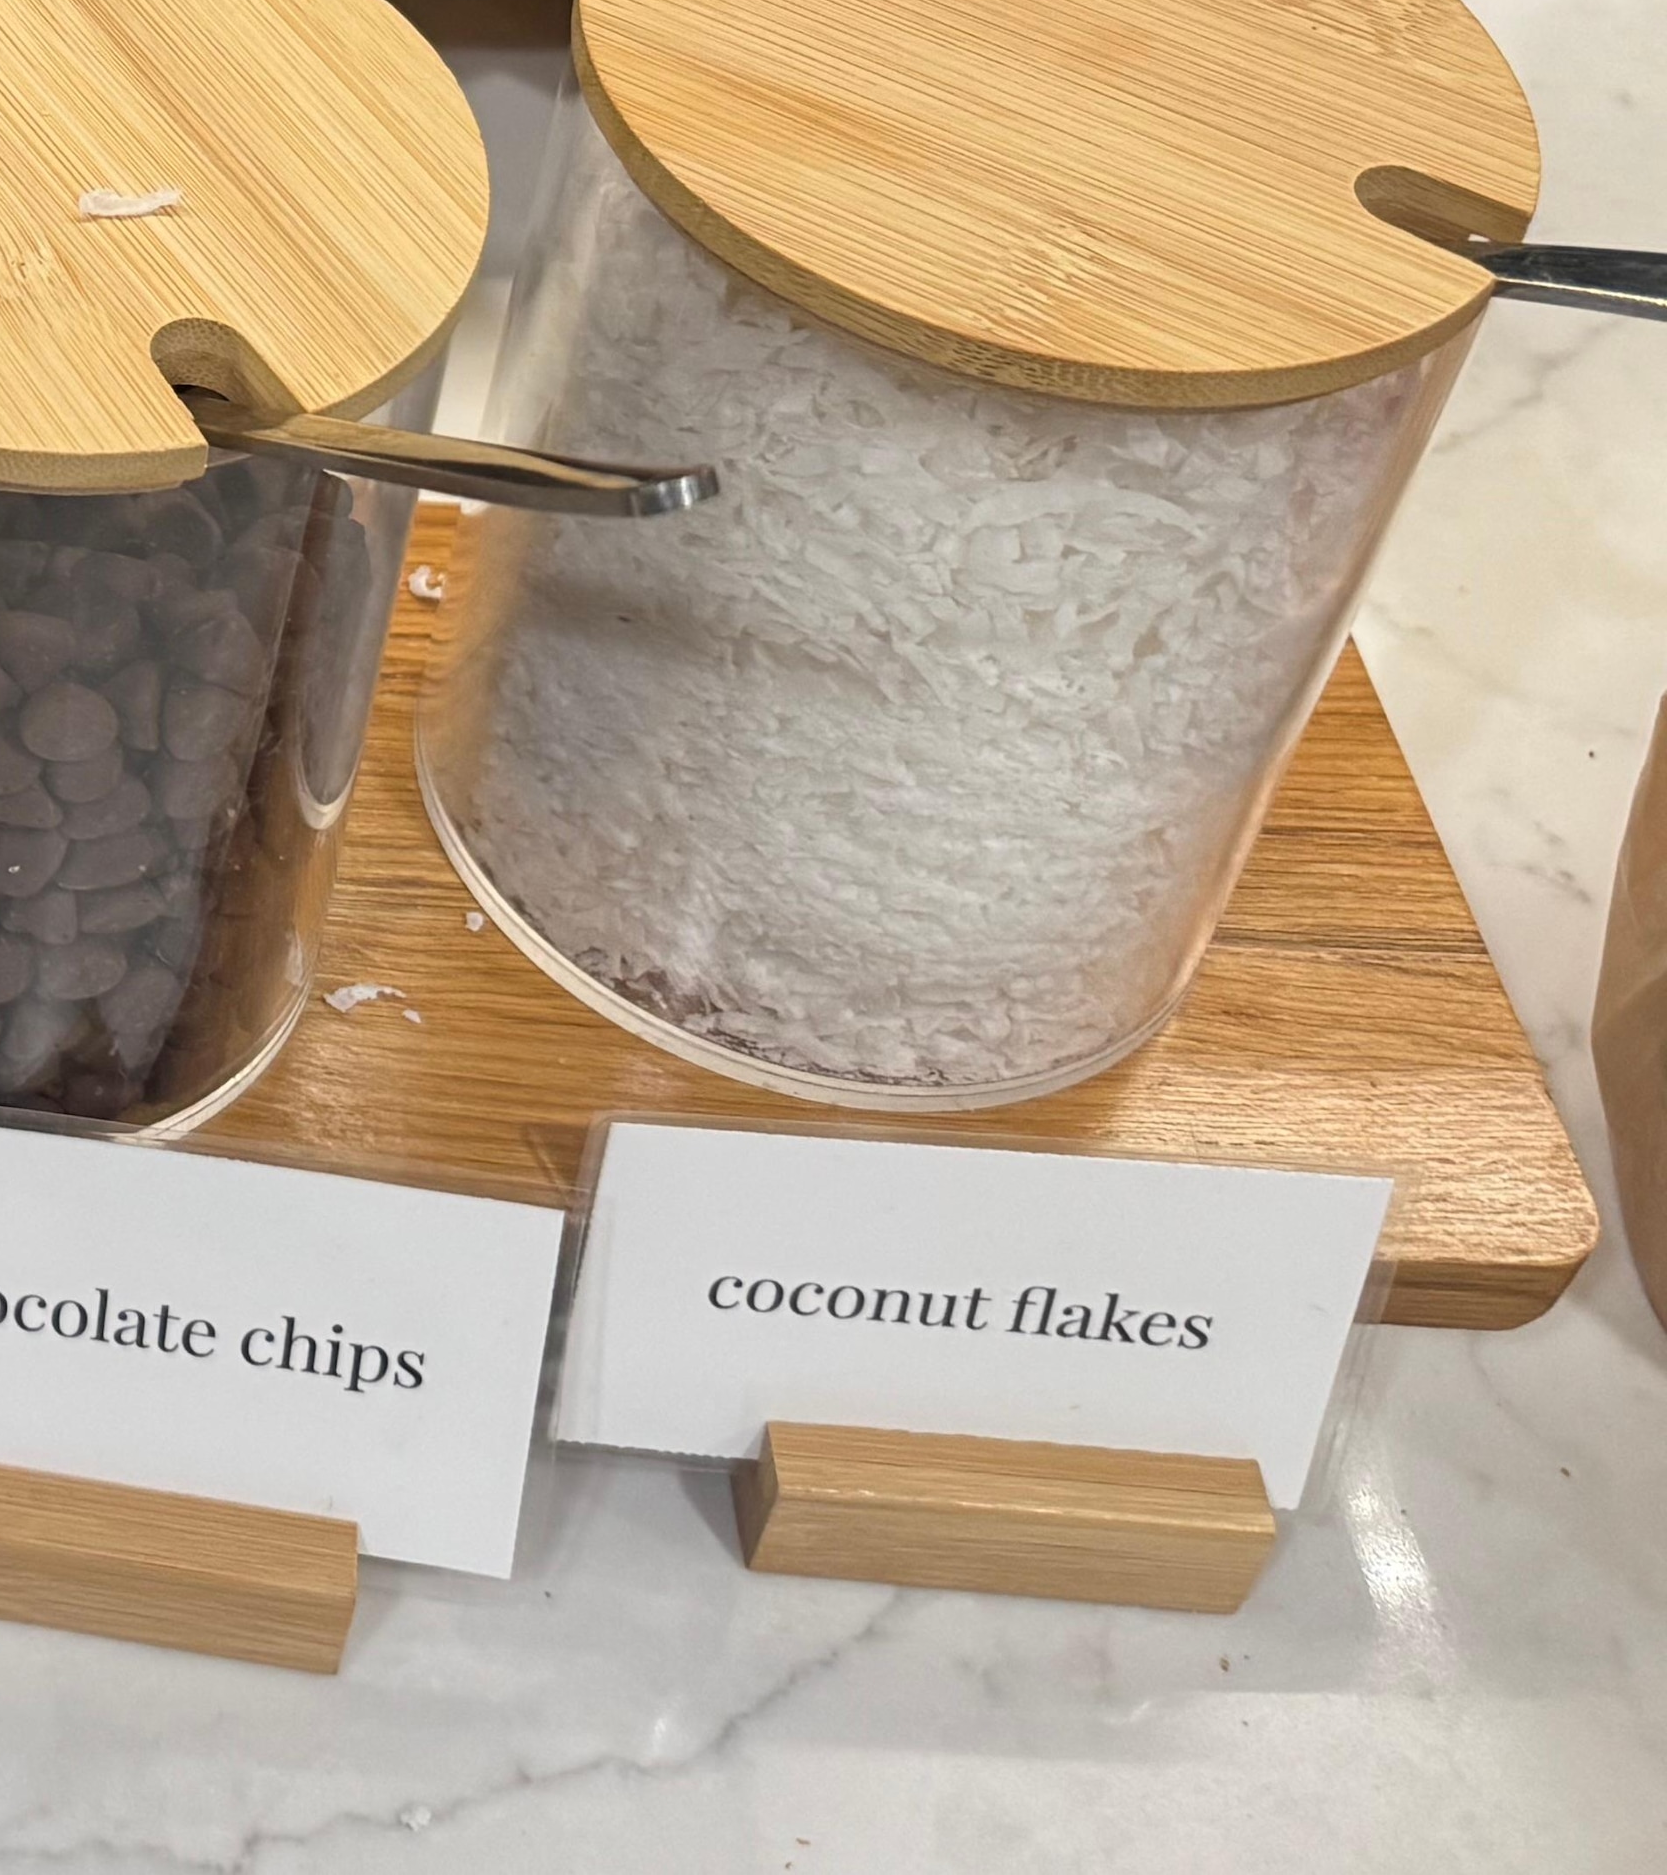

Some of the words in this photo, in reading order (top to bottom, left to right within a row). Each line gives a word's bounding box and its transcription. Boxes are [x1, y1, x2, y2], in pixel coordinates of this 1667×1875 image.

[708, 1276, 993, 1332] coconut
[1006, 1286, 1214, 1351] flakes
[240, 1315, 426, 1394] chips
